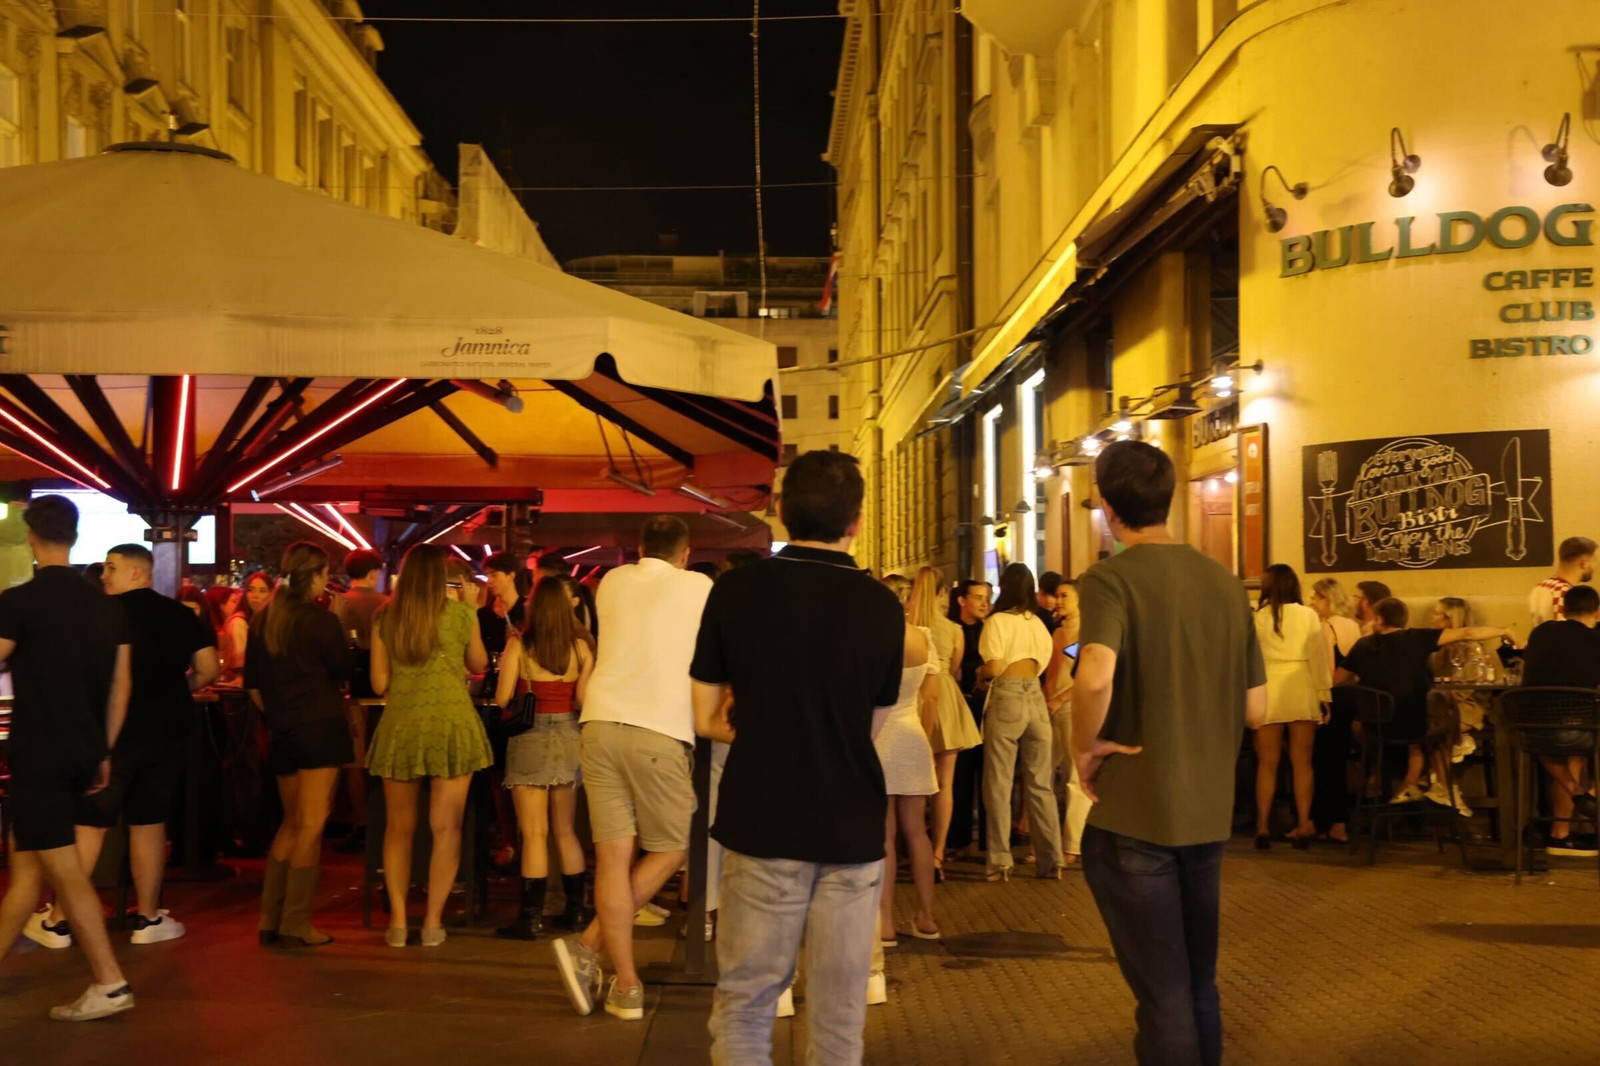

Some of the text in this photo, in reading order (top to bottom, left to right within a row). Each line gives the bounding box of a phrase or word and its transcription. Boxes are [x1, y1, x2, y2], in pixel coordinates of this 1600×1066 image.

[1281, 204, 1594, 278] BULLDOG
[1483, 268, 1594, 291] CAFFE
[1500, 301, 1595, 323] CLUB
[441, 337, 530, 358] Jamnica
[1469, 335, 1594, 359] BISTRO
[1420, 447, 1455, 477] good
[1434, 522, 1465, 540] the
